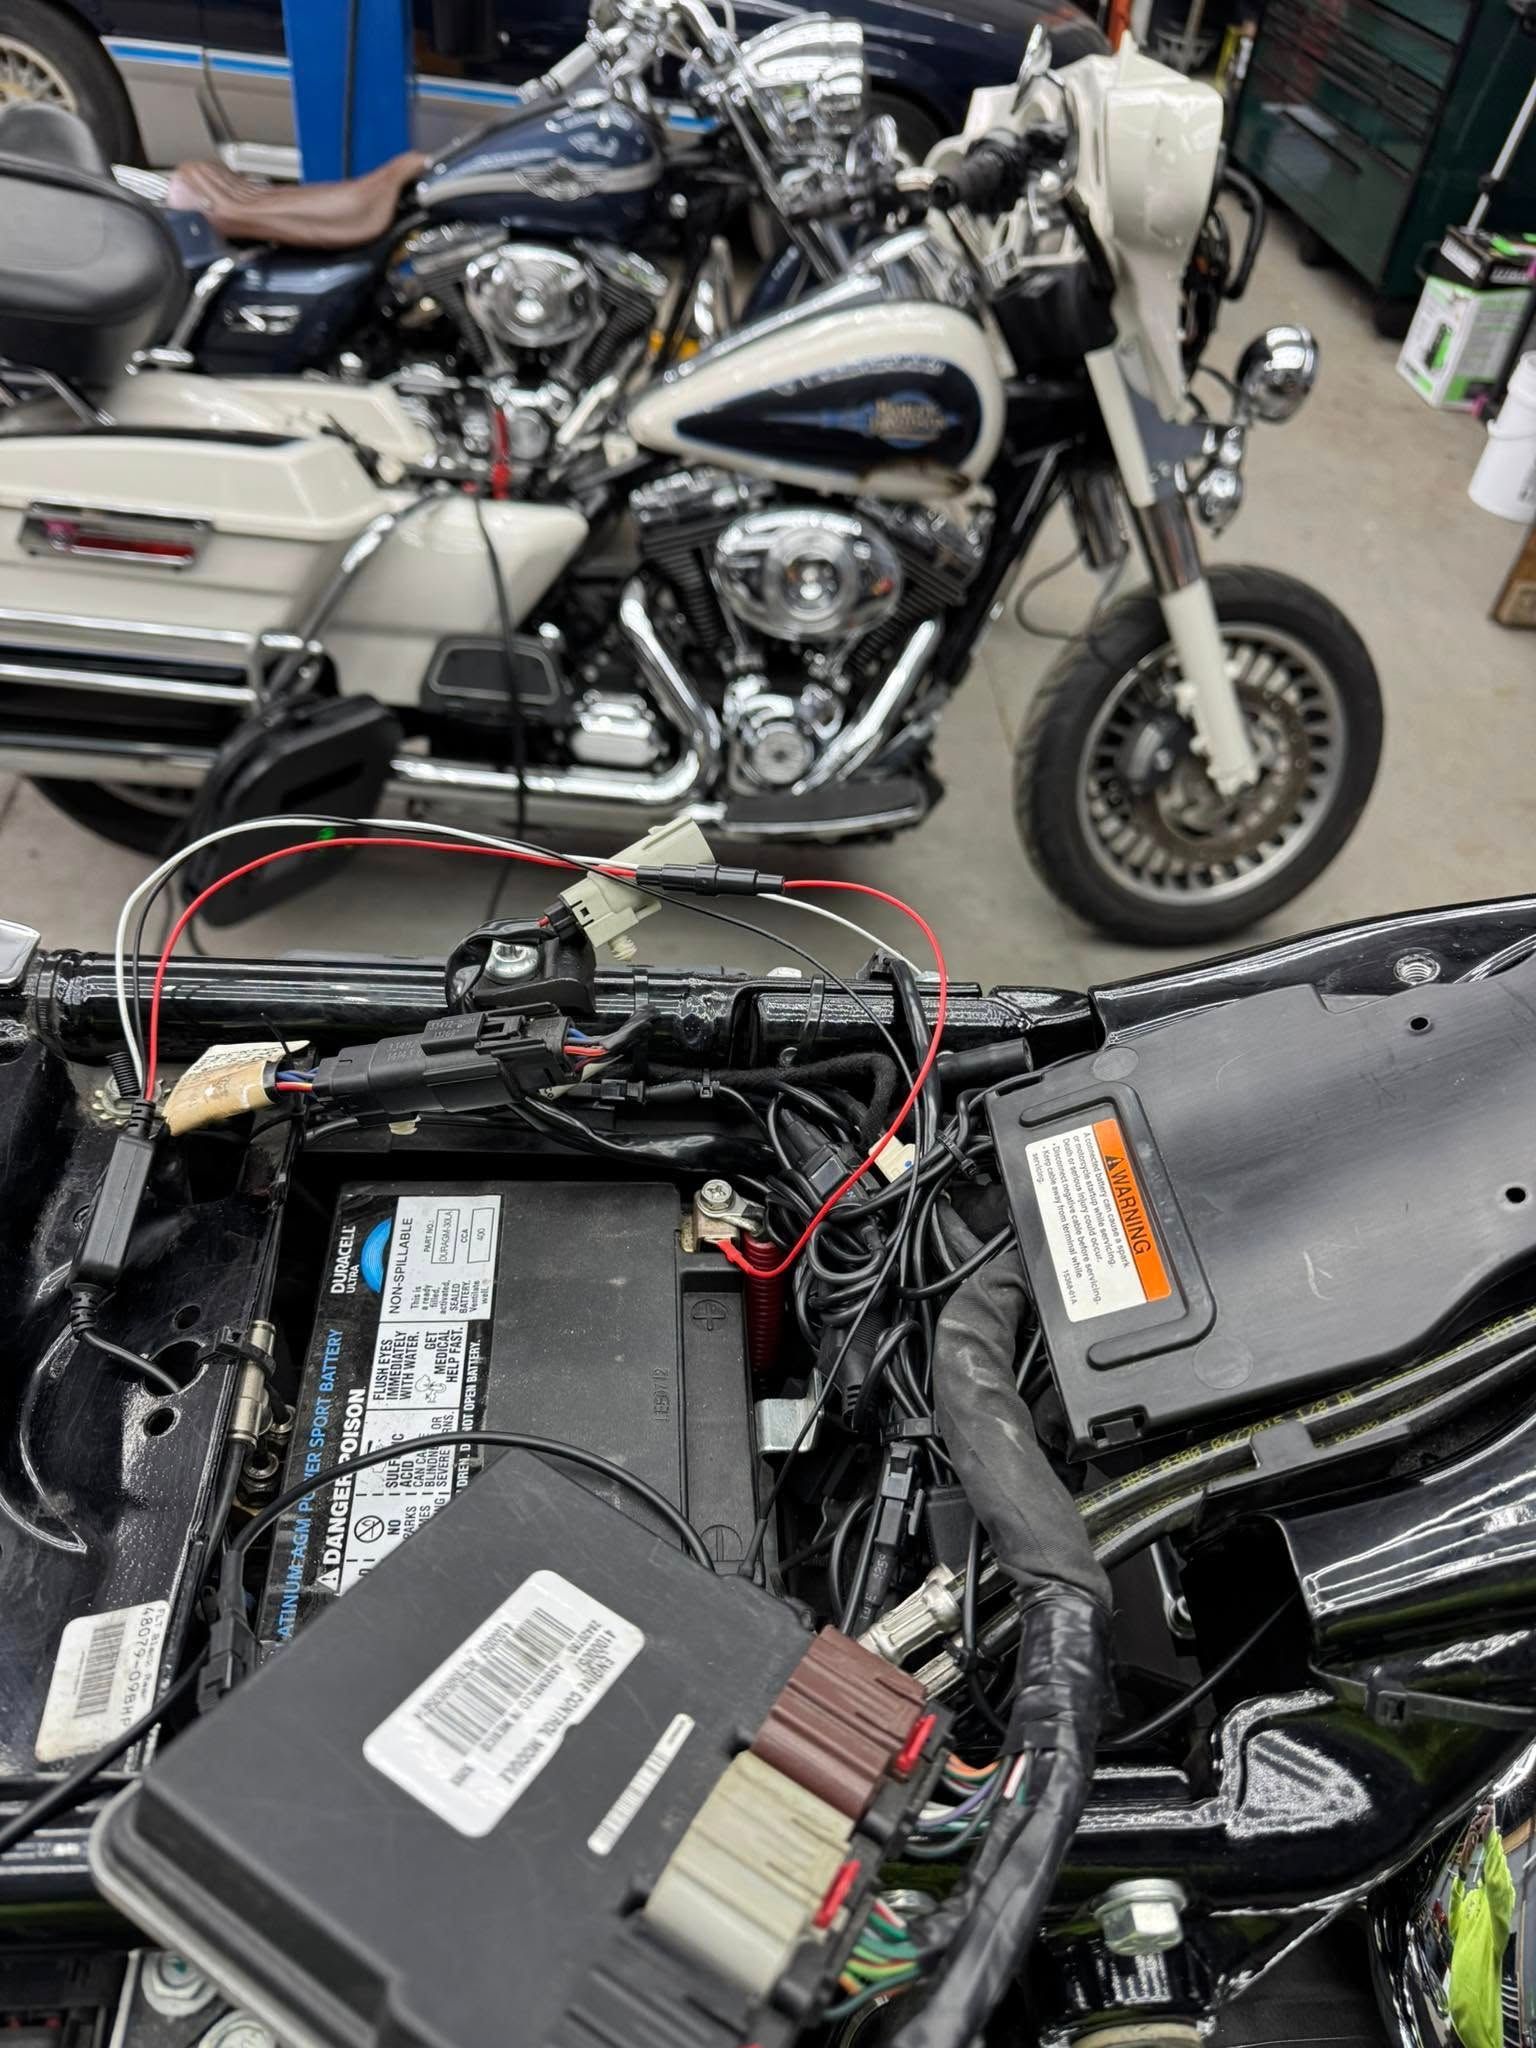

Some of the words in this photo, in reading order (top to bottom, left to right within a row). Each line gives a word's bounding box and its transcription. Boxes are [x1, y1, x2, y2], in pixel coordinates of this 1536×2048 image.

[1040, 1149, 1052, 1167] Keep
[1062, 1138, 1073, 1157] Death
[1067, 1157, 1074, 1165] or
[1072, 1142, 1091, 1180] motorcycle
[1029, 1152, 1045, 1185] servicing.
[1045, 1166, 1057, 1185] cable
[1051, 1145, 1068, 1183] Disconnect
[1069, 1165, 1082, 1191] serious
[1050, 1186, 1061, 1204] away
[1061, 1183, 1076, 1214] negative
[1076, 1191, 1089, 1213] injury
[1084, 1180, 1098, 1206] startup
[1084, 1137, 1100, 1172] connected
[1094, 1172, 1107, 1198] battery
[1102, 1198, 1111, 1212] can
[1107, 1213, 1119, 1237] cause
[1115, 1244, 1130, 1268] spark
[1056, 1204, 1067, 1222] from
[1071, 1214, 1083, 1235] cable
[1083, 1214, 1096, 1236] could
[1092, 1206, 1105, 1227] while
[1109, 1169, 1152, 1255] WARNING
[423, 1236, 432, 1251] PART
[477, 1228, 485, 1240] 400
[1061, 1222, 1077, 1255] terminal
[1098, 1227, 1117, 1267] servicing.
[331, 1225, 356, 1293] DURACELL
[1077, 1235, 1091, 1262] before
[1090, 1237, 1103, 1262] occur.
[346, 1264, 359, 1293] ULTRA
[389, 1217, 413, 1313] NON-SPILLABLE
[1070, 1256, 1083, 1278] while
[422, 1284, 432, 1304] ready
[449, 1283, 460, 1310] SEALED
[469, 1280, 480, 1312] Ventilate
[1083, 1263, 1103, 1305] servicing.
[411, 1294, 420, 1308] This
[378, 1339, 392, 1362] EYES
[403, 1331, 419, 1368] WATER.
[424, 1331, 437, 1349] GET
[433, 1330, 450, 1373] MEDICAL
[449, 1326, 463, 1354] FAST.
[318, 1328, 342, 1392] BATTERY
[386, 1331, 406, 1400] IMMEDIATELY
[445, 1357, 460, 1382] HELP
[466, 1339, 481, 1381] BATTERY.
[373, 1366, 388, 1399] FLUSH
[399, 1372, 414, 1399] WITH
[463, 1383, 477, 1410] OPEN
[309, 1396, 331, 1447] SPORT
[431, 1416, 442, 1428] OR
[385, 1433, 404, 1487] SULFC
[400, 1459, 414, 1487] ACID
[436, 1448, 450, 1486] SEVERE
[298, 1452, 321, 1512] POER
[413, 1468, 425, 1486] CAN
[323, 1470, 353, 1565] DANGER
[387, 1519, 400, 1536] NO
[402, 1505, 416, 1539] PARKS
[292, 1517, 311, 1557] AGM
[276, 1564, 303, 1638] ATINUM
[154, 1607, 165, 1626] FLT
[515, 1661, 563, 1712] ASSEMBLED
[576, 1654, 615, 1694] ENGINE
[537, 1690, 583, 1740] CONTROL
[498, 1736, 544, 1785] MODULE
